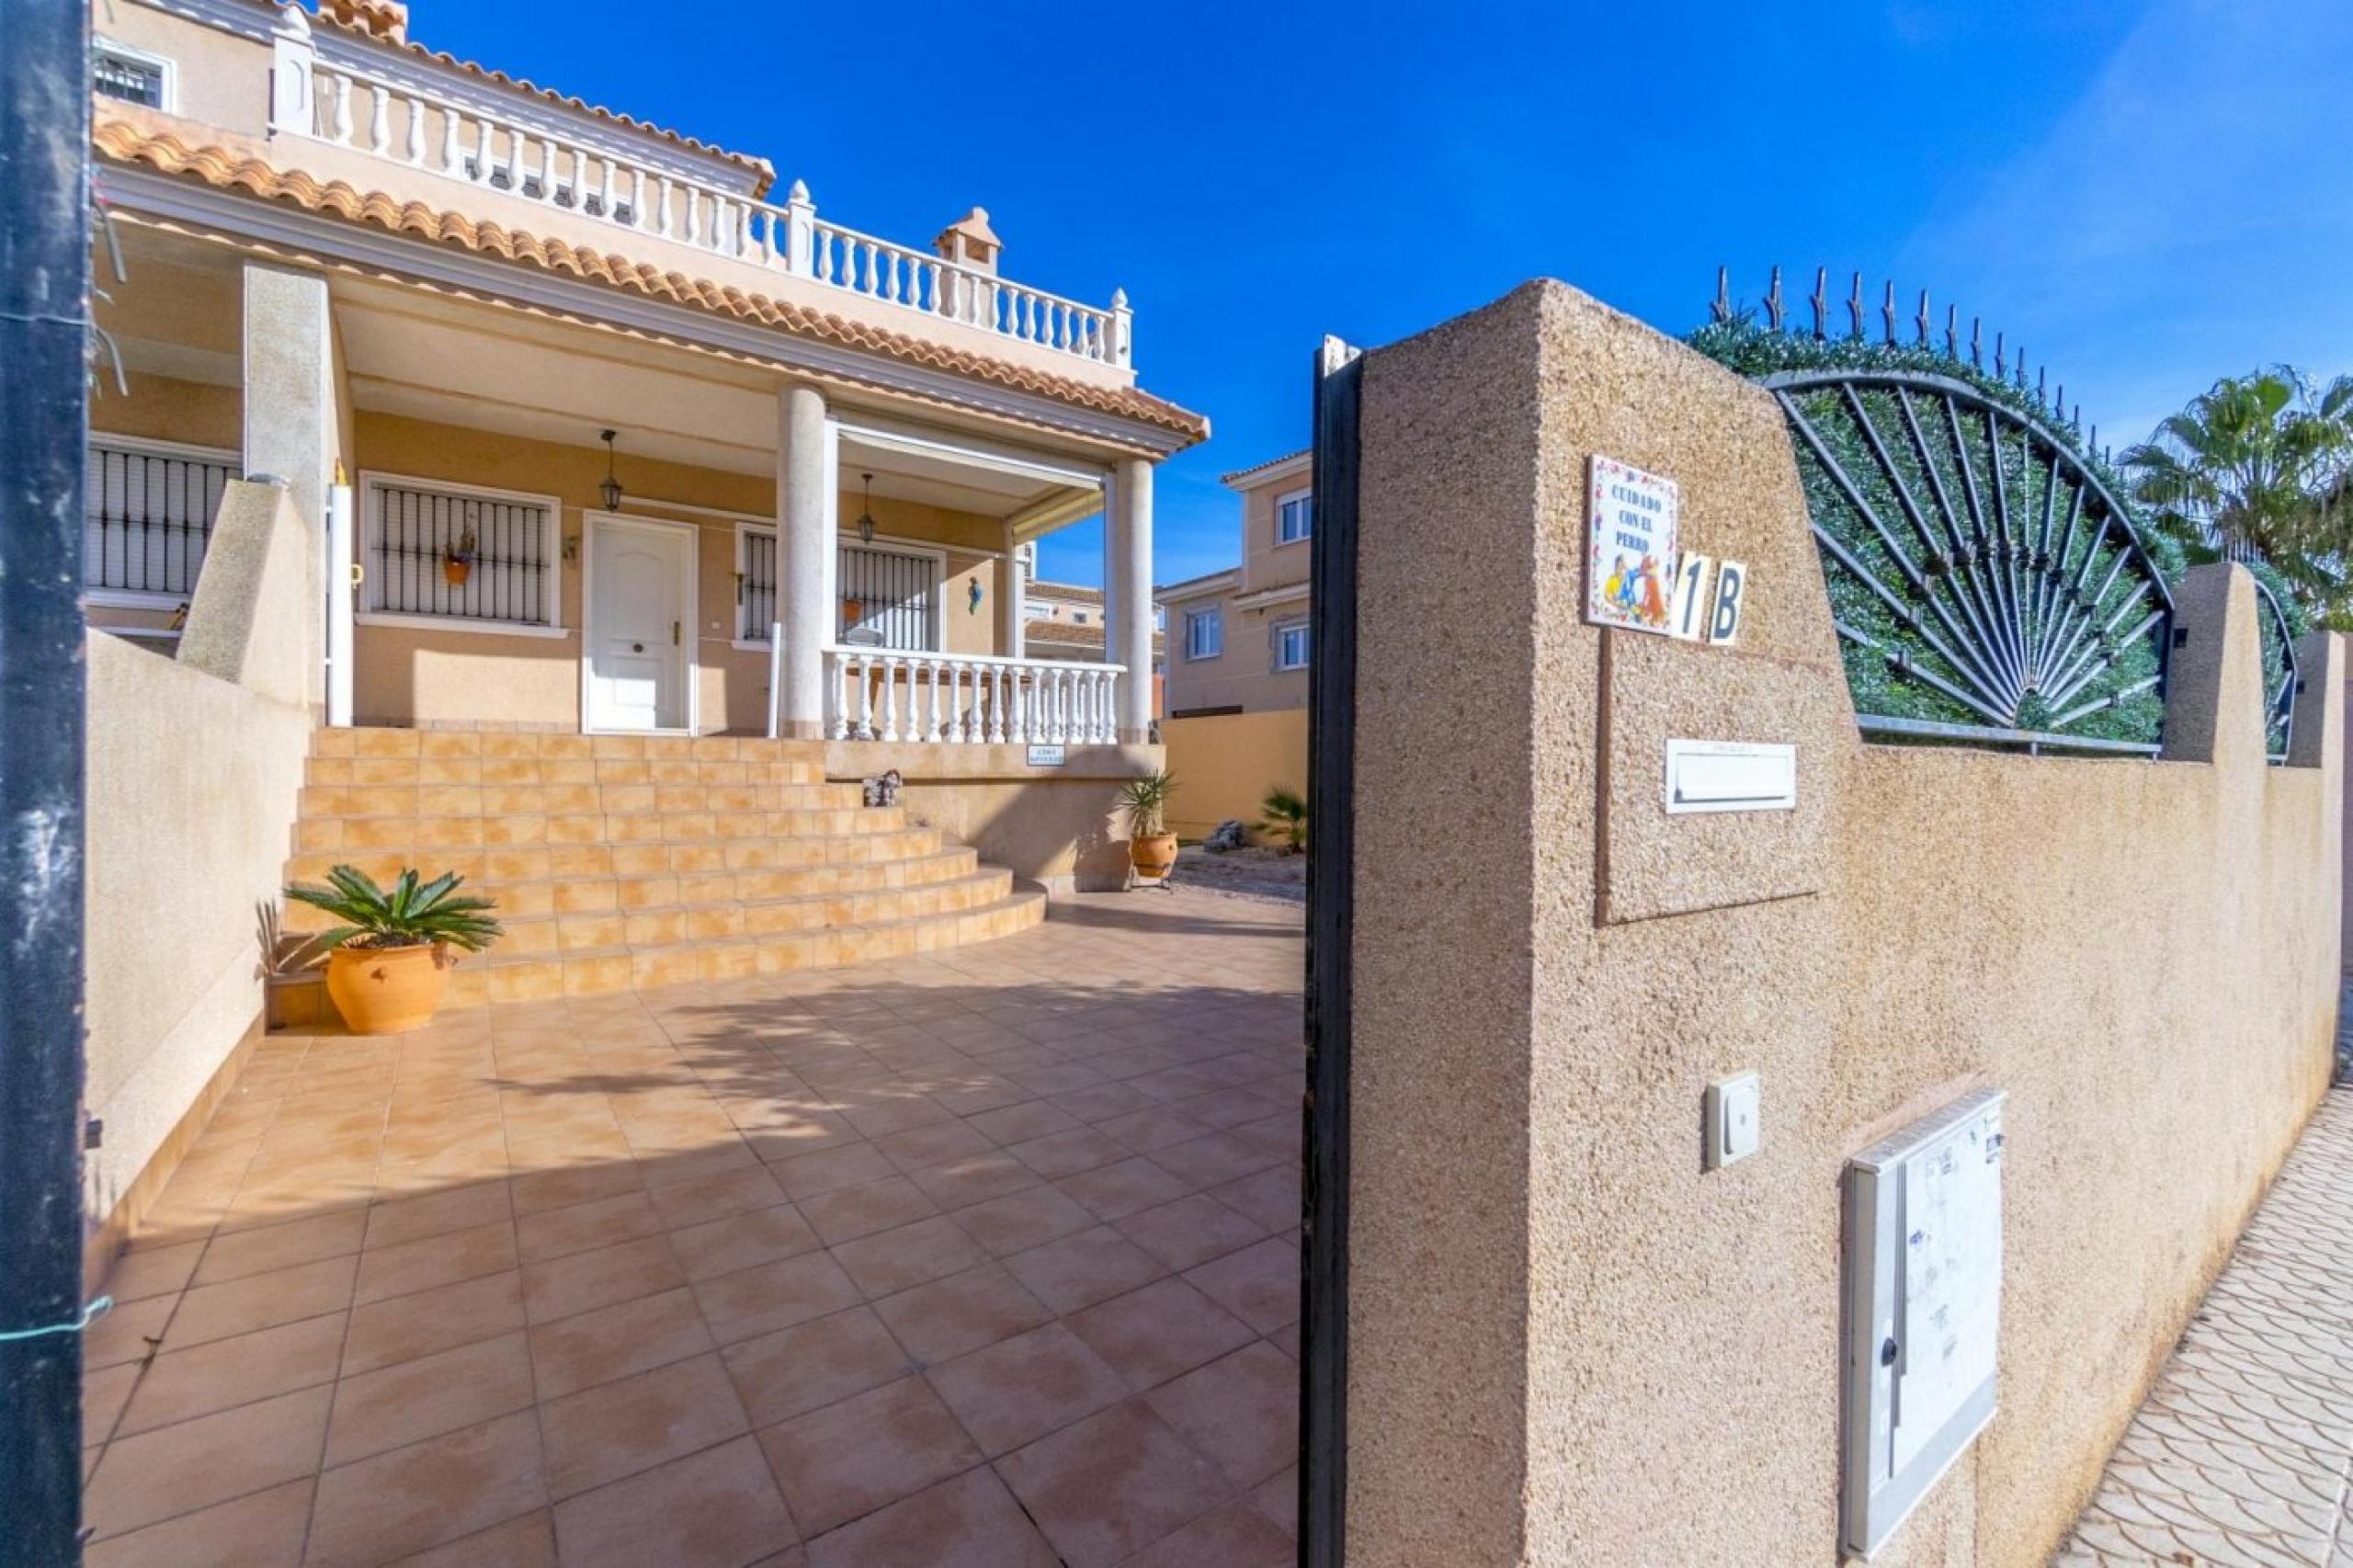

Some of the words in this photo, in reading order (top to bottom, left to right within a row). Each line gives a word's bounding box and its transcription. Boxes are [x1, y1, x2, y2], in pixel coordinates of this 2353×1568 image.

[1611, 484, 1661, 513] CUIDADO
[1619, 509, 1639, 528] CON
[1642, 516, 1653, 532] EL
[1616, 530, 1649, 553] PERRO
